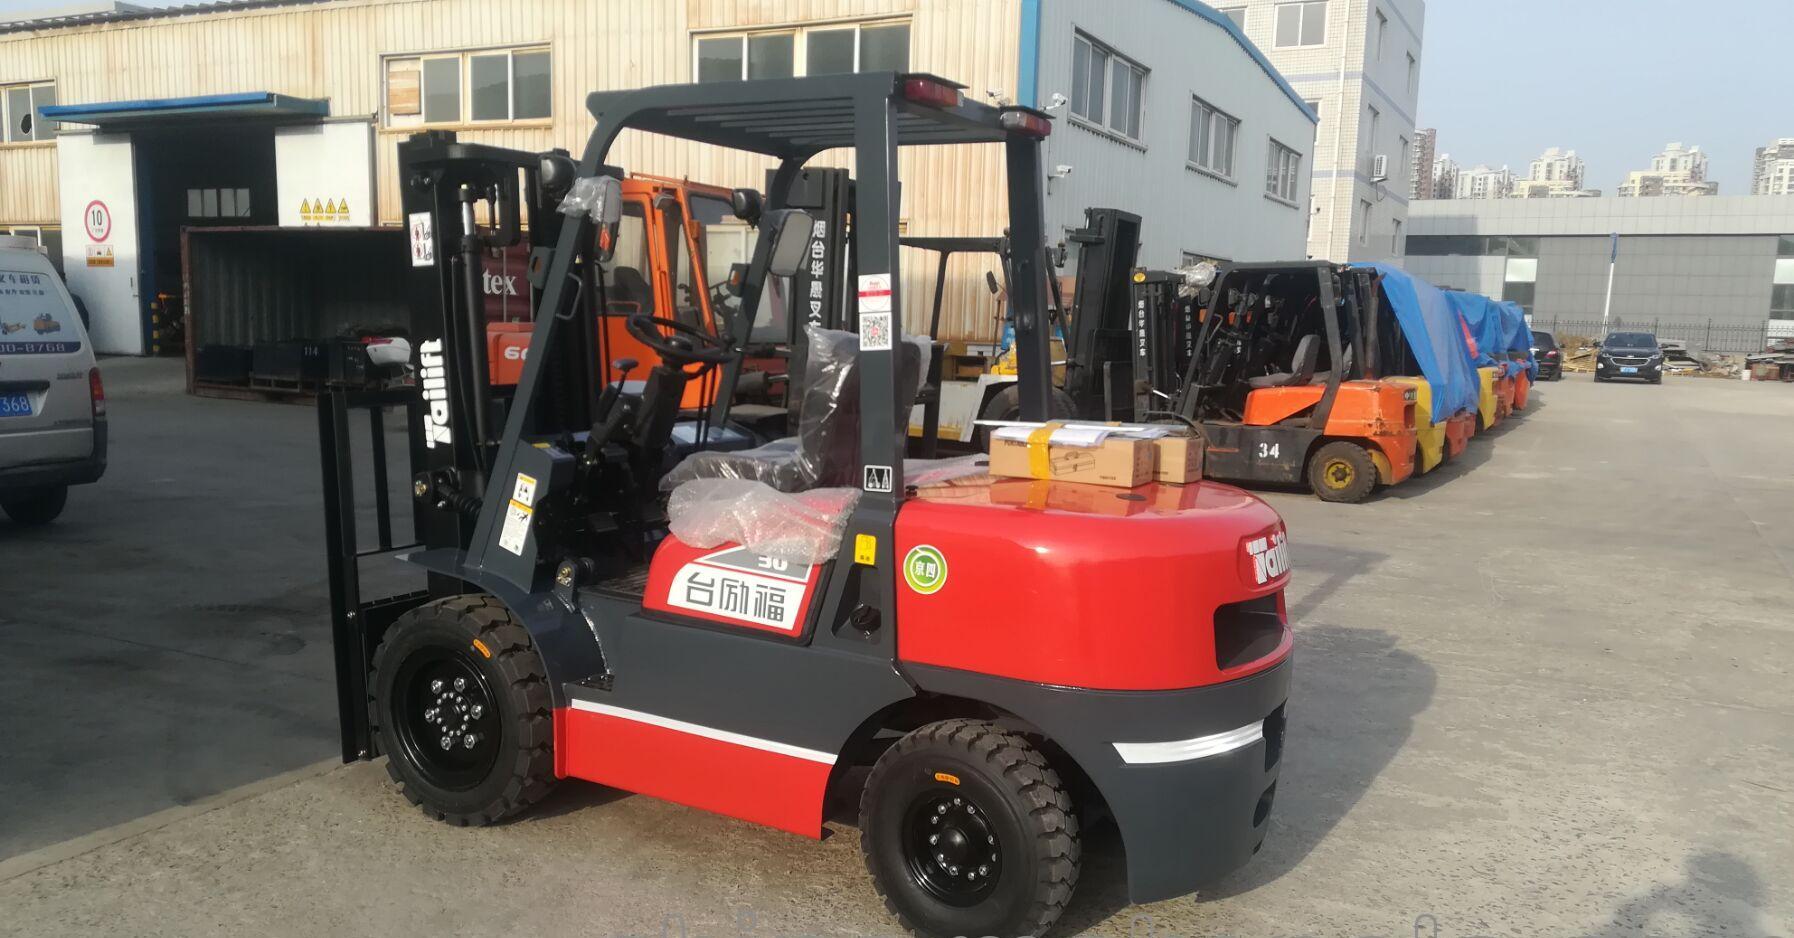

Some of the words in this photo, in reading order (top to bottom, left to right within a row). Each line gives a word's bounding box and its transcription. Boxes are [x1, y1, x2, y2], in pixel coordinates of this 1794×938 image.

[92, 209, 103, 226] 10
[483, 269, 517, 296] tex
[419, 338, 451, 449] Tailift
[1258, 443, 1280, 459] 34
[686, 572, 786, 622] 台励福
